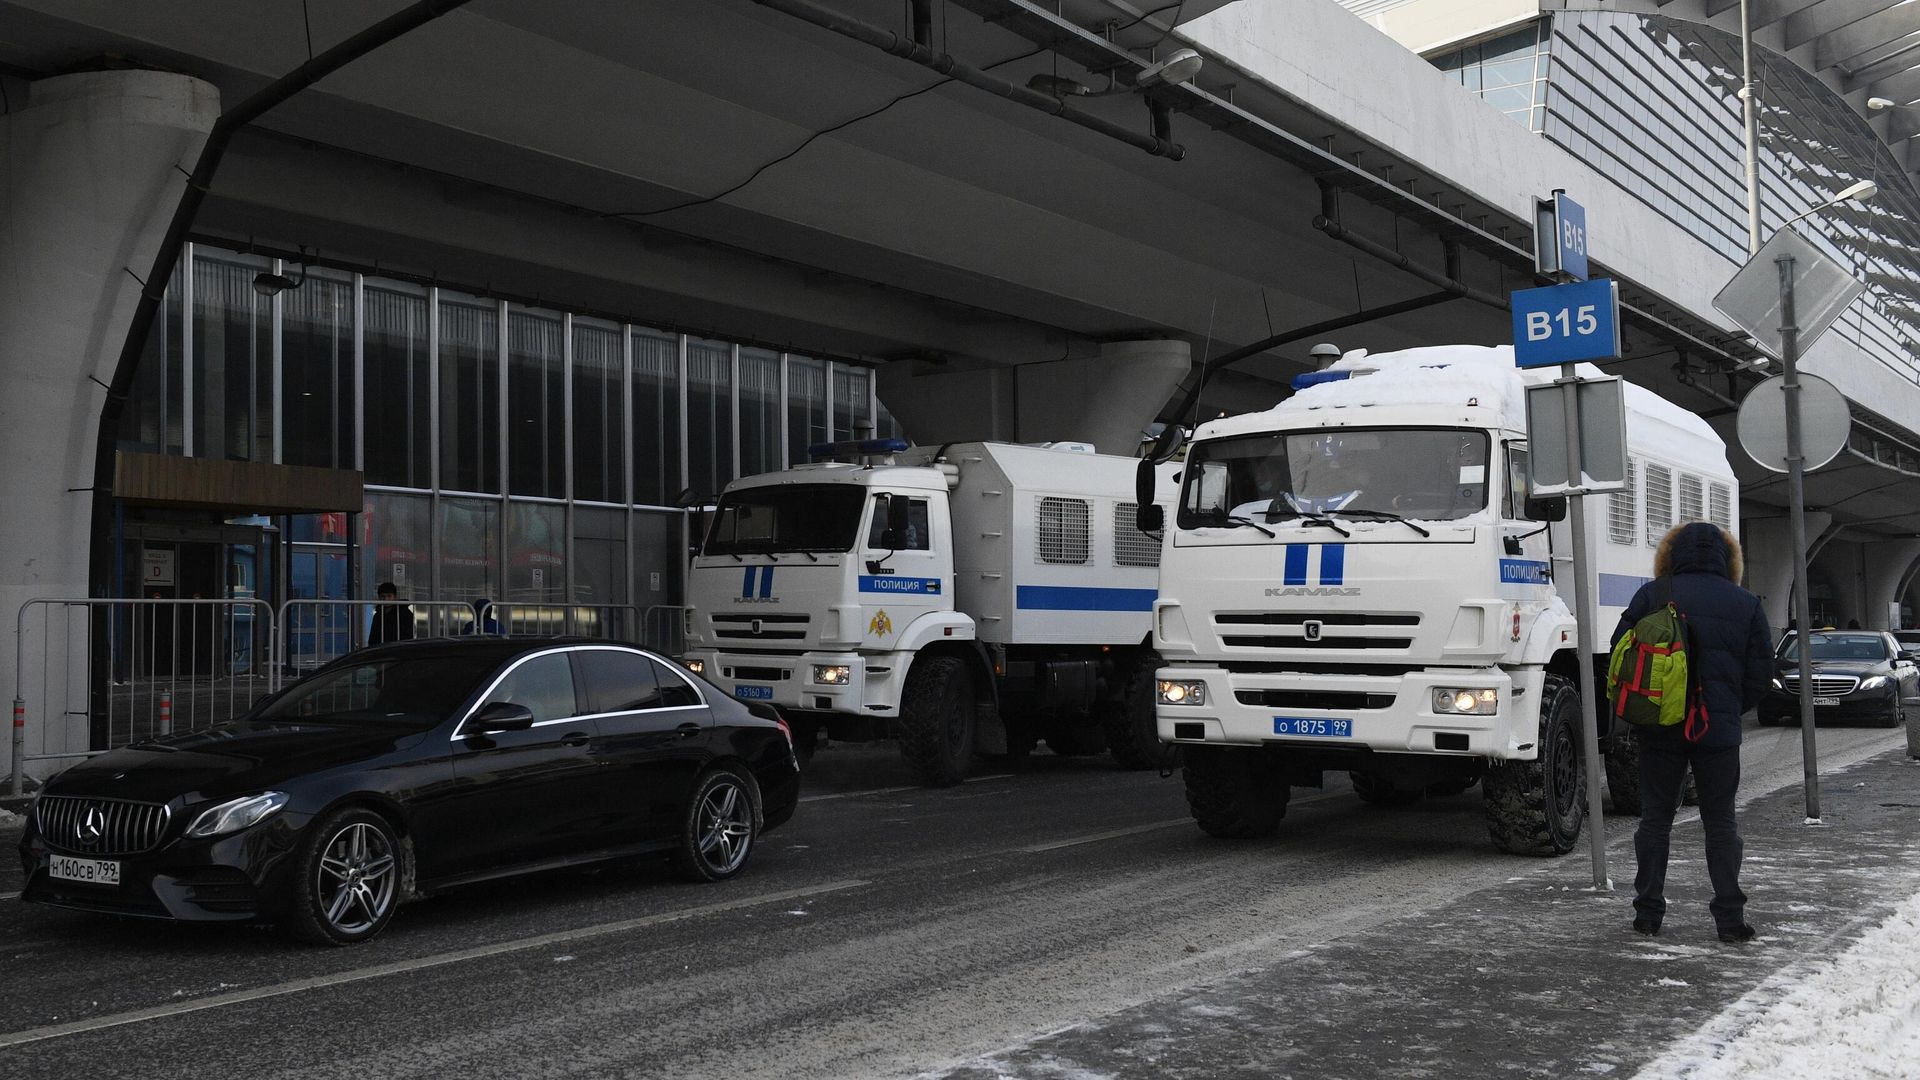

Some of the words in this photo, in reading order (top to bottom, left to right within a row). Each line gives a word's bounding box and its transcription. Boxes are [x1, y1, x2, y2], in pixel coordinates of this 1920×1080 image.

[1563, 218, 1584, 257] B15
[1526, 304, 1598, 342] B15
[153, 566, 161, 577] D
[1503, 564, 1540, 581] ПОЛИЦИЯ
[874, 579, 920, 591] ПОЛИЦИЯ
[1264, 587, 1361, 597] KAMAZ
[743, 687, 760, 697] 5160
[1293, 719, 1326, 734] 1875
[1333, 720, 1348, 731] 99
[96, 861, 117, 877] 799
